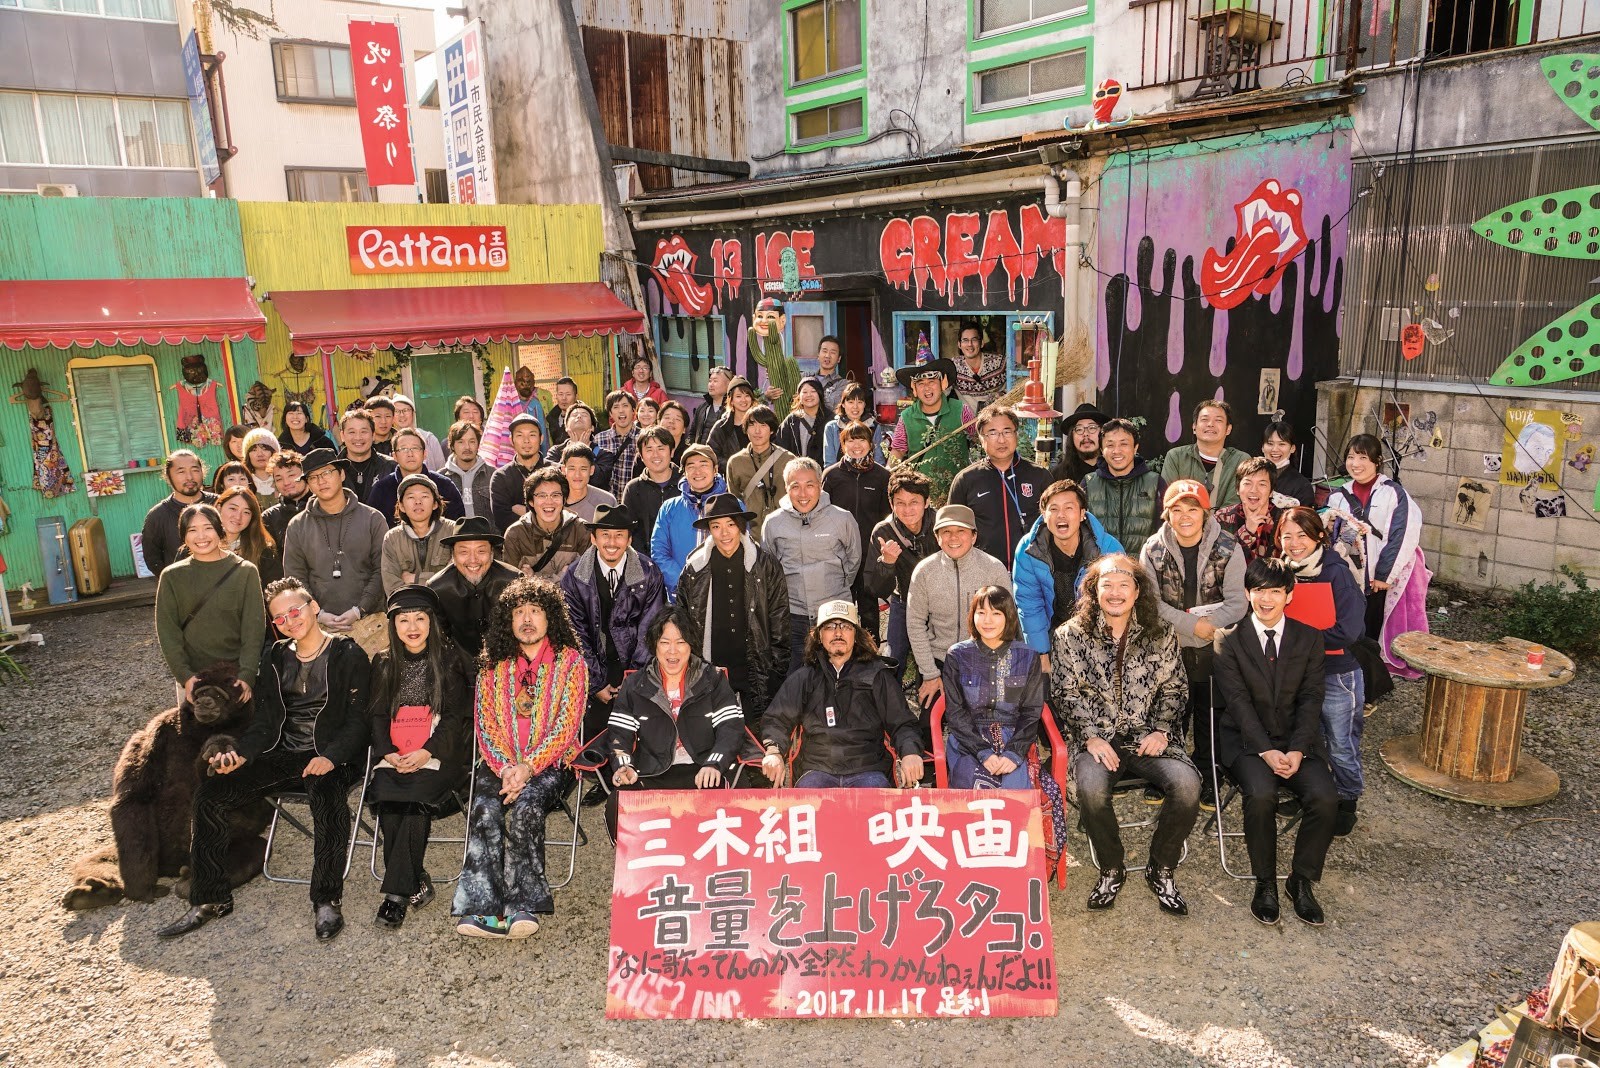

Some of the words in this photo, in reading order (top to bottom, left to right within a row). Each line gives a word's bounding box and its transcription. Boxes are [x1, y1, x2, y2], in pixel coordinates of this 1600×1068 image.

[358, 229, 486, 269] Pattani
[710, 238, 743, 309] 13
[755, 229, 816, 299] ICE
[879, 203, 1067, 308] CREAM
[1178, 482, 1199, 494] NY
[627, 804, 822, 870] 三木組
[867, 796, 1029, 870] 映画
[796, 987, 927, 1016] 2017.11.17
[935, 987, 991, 1017] 足利
